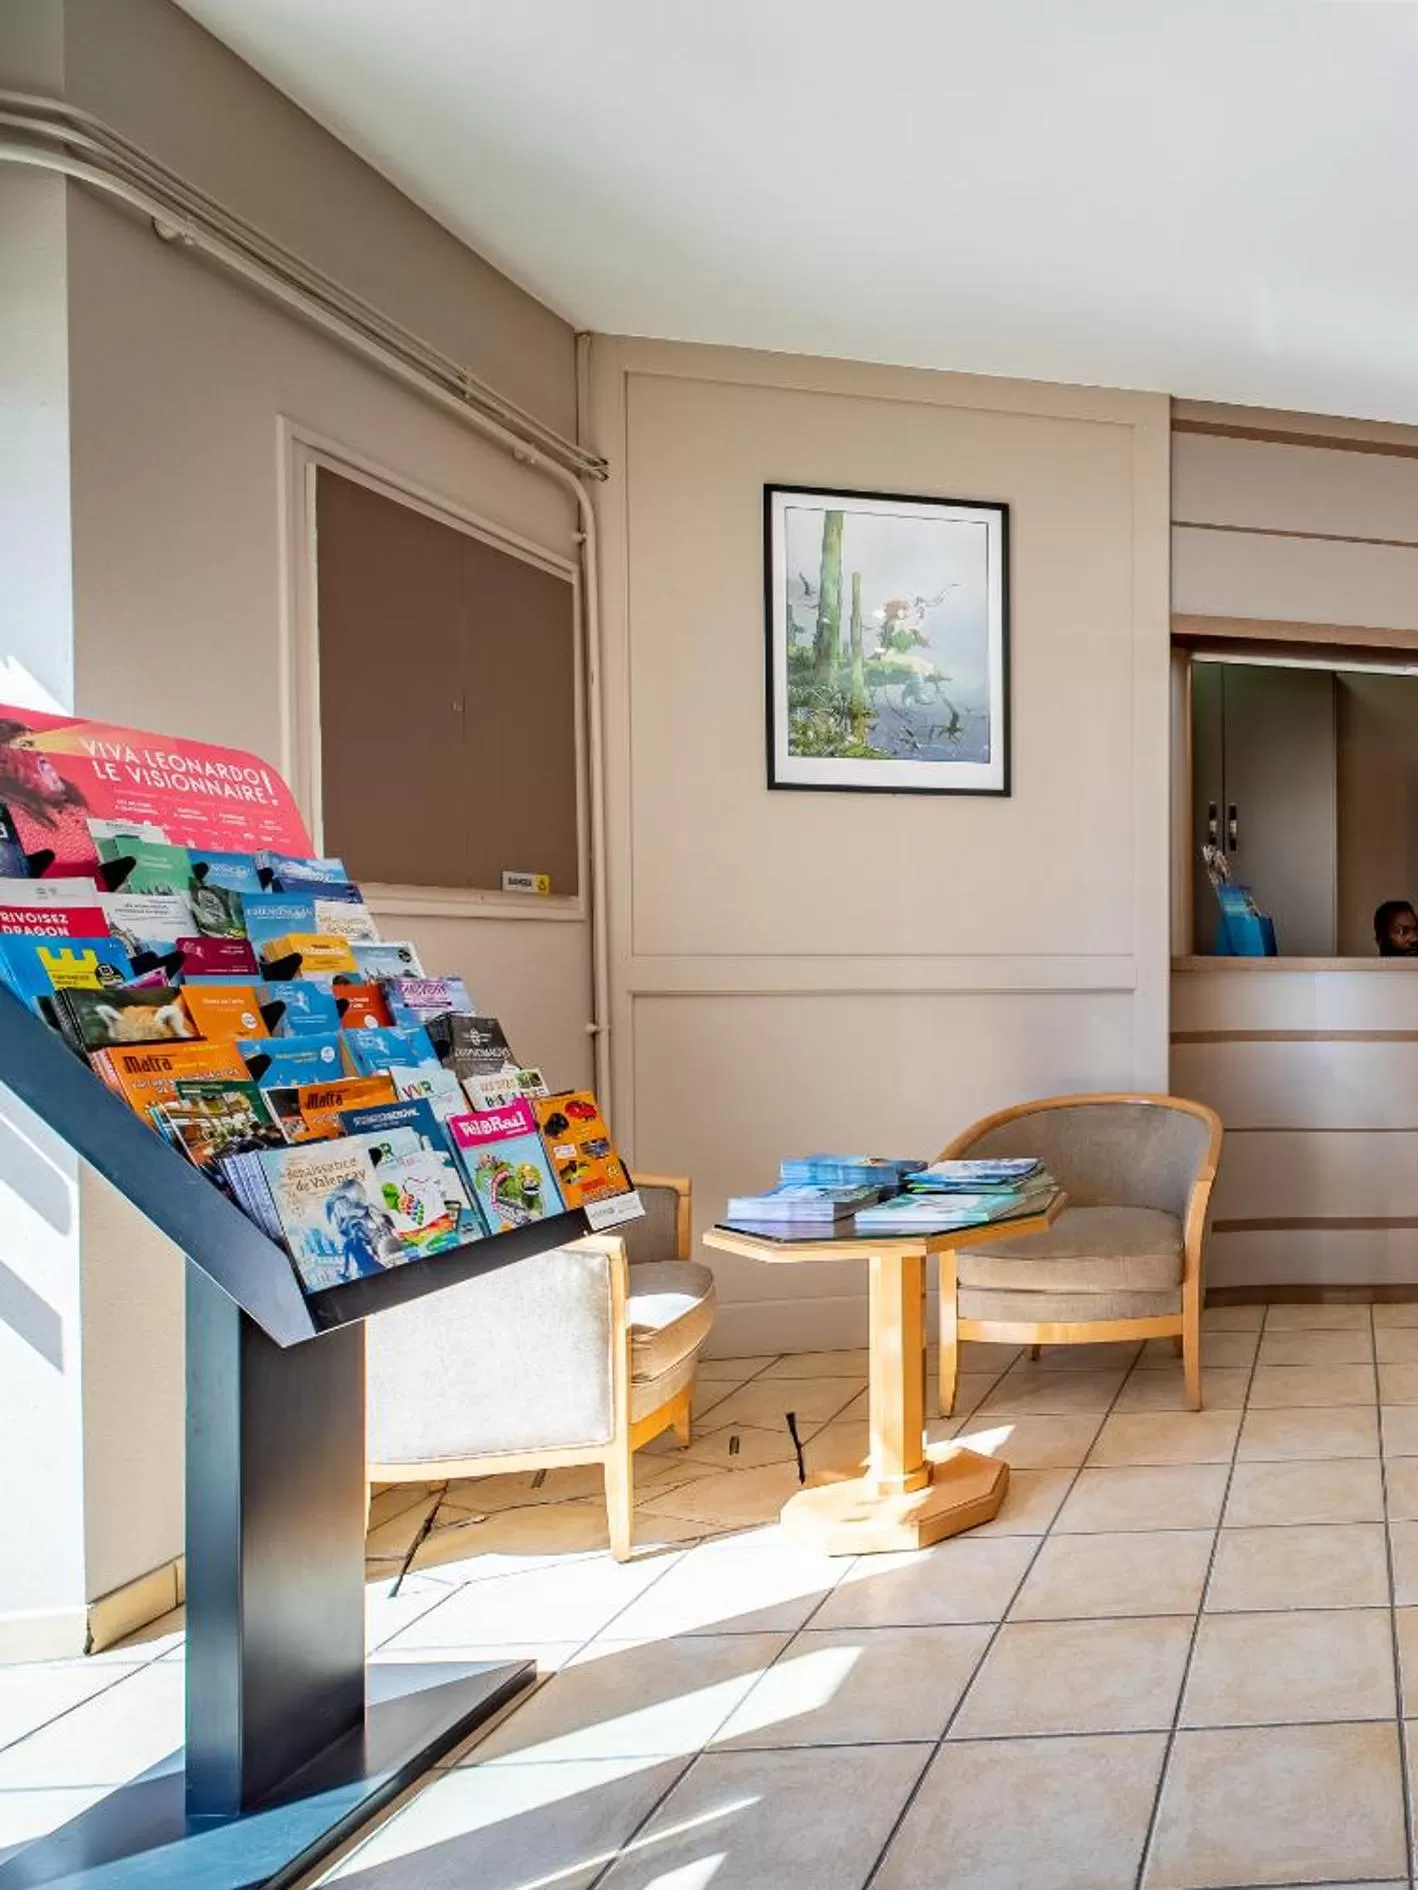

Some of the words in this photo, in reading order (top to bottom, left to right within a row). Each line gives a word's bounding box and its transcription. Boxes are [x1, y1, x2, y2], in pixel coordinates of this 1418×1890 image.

[84, 740, 140, 764] VIVA
[144, 749, 260, 783] LEONARDO
[92, 760, 121, 782] LE
[122, 1053, 174, 1075] Matra
